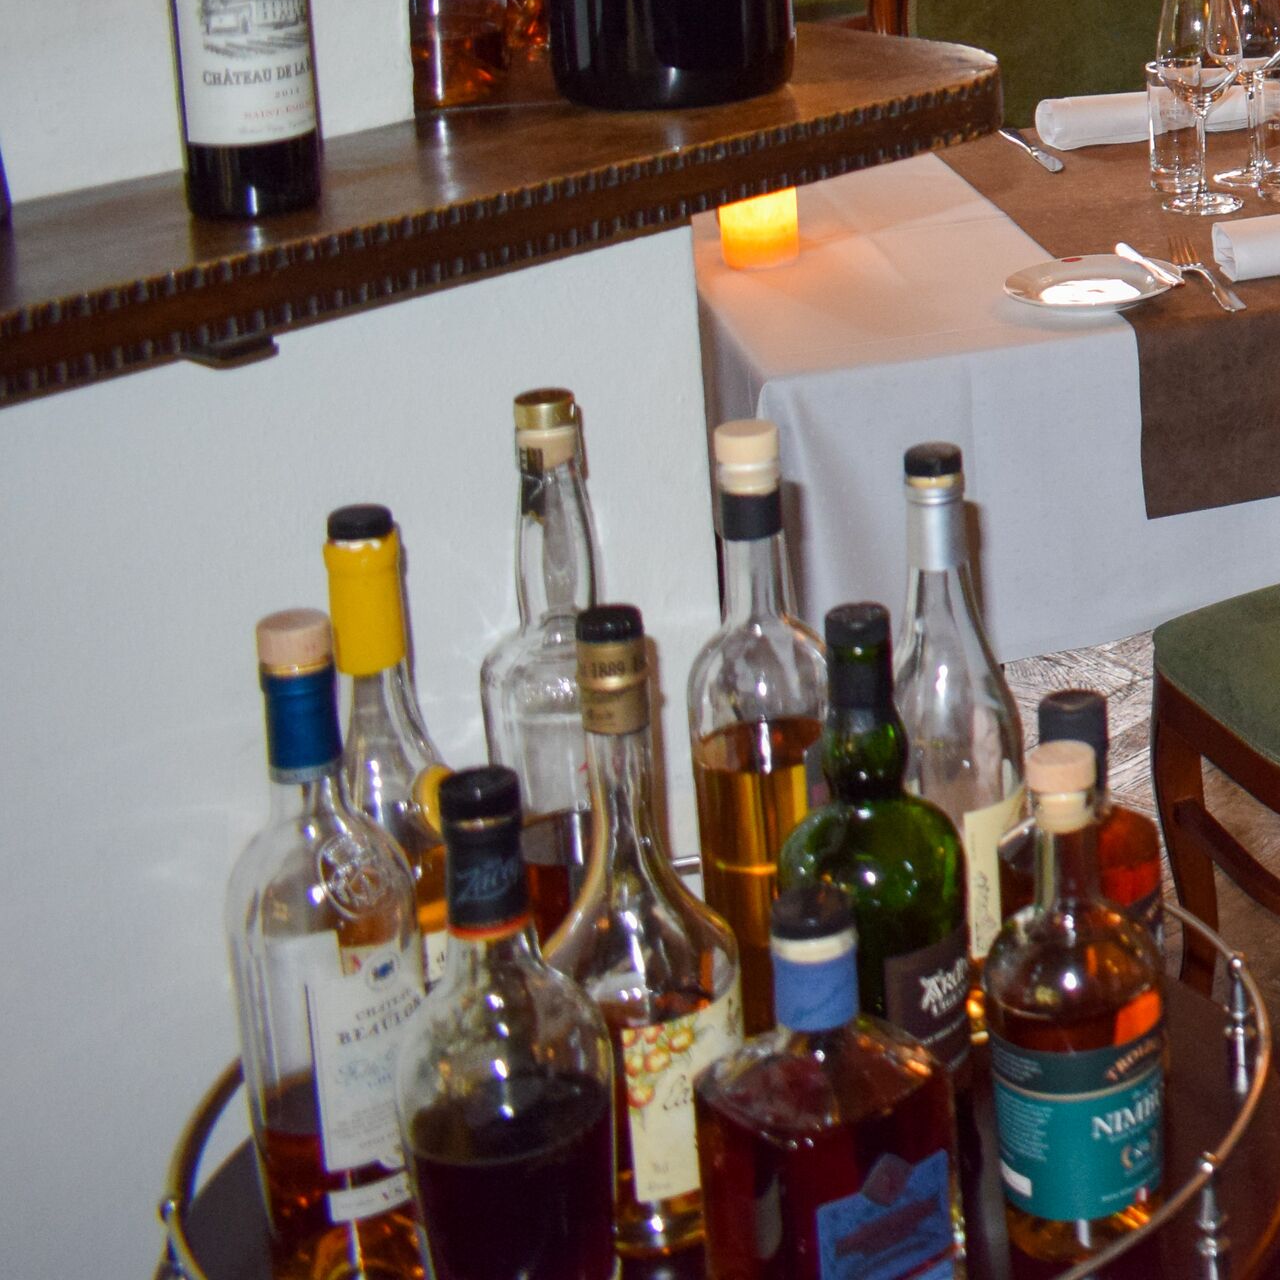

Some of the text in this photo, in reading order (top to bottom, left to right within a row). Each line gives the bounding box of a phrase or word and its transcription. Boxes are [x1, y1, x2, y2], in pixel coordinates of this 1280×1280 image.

[203, 62, 307, 87] CHÂTEAU DE LA
